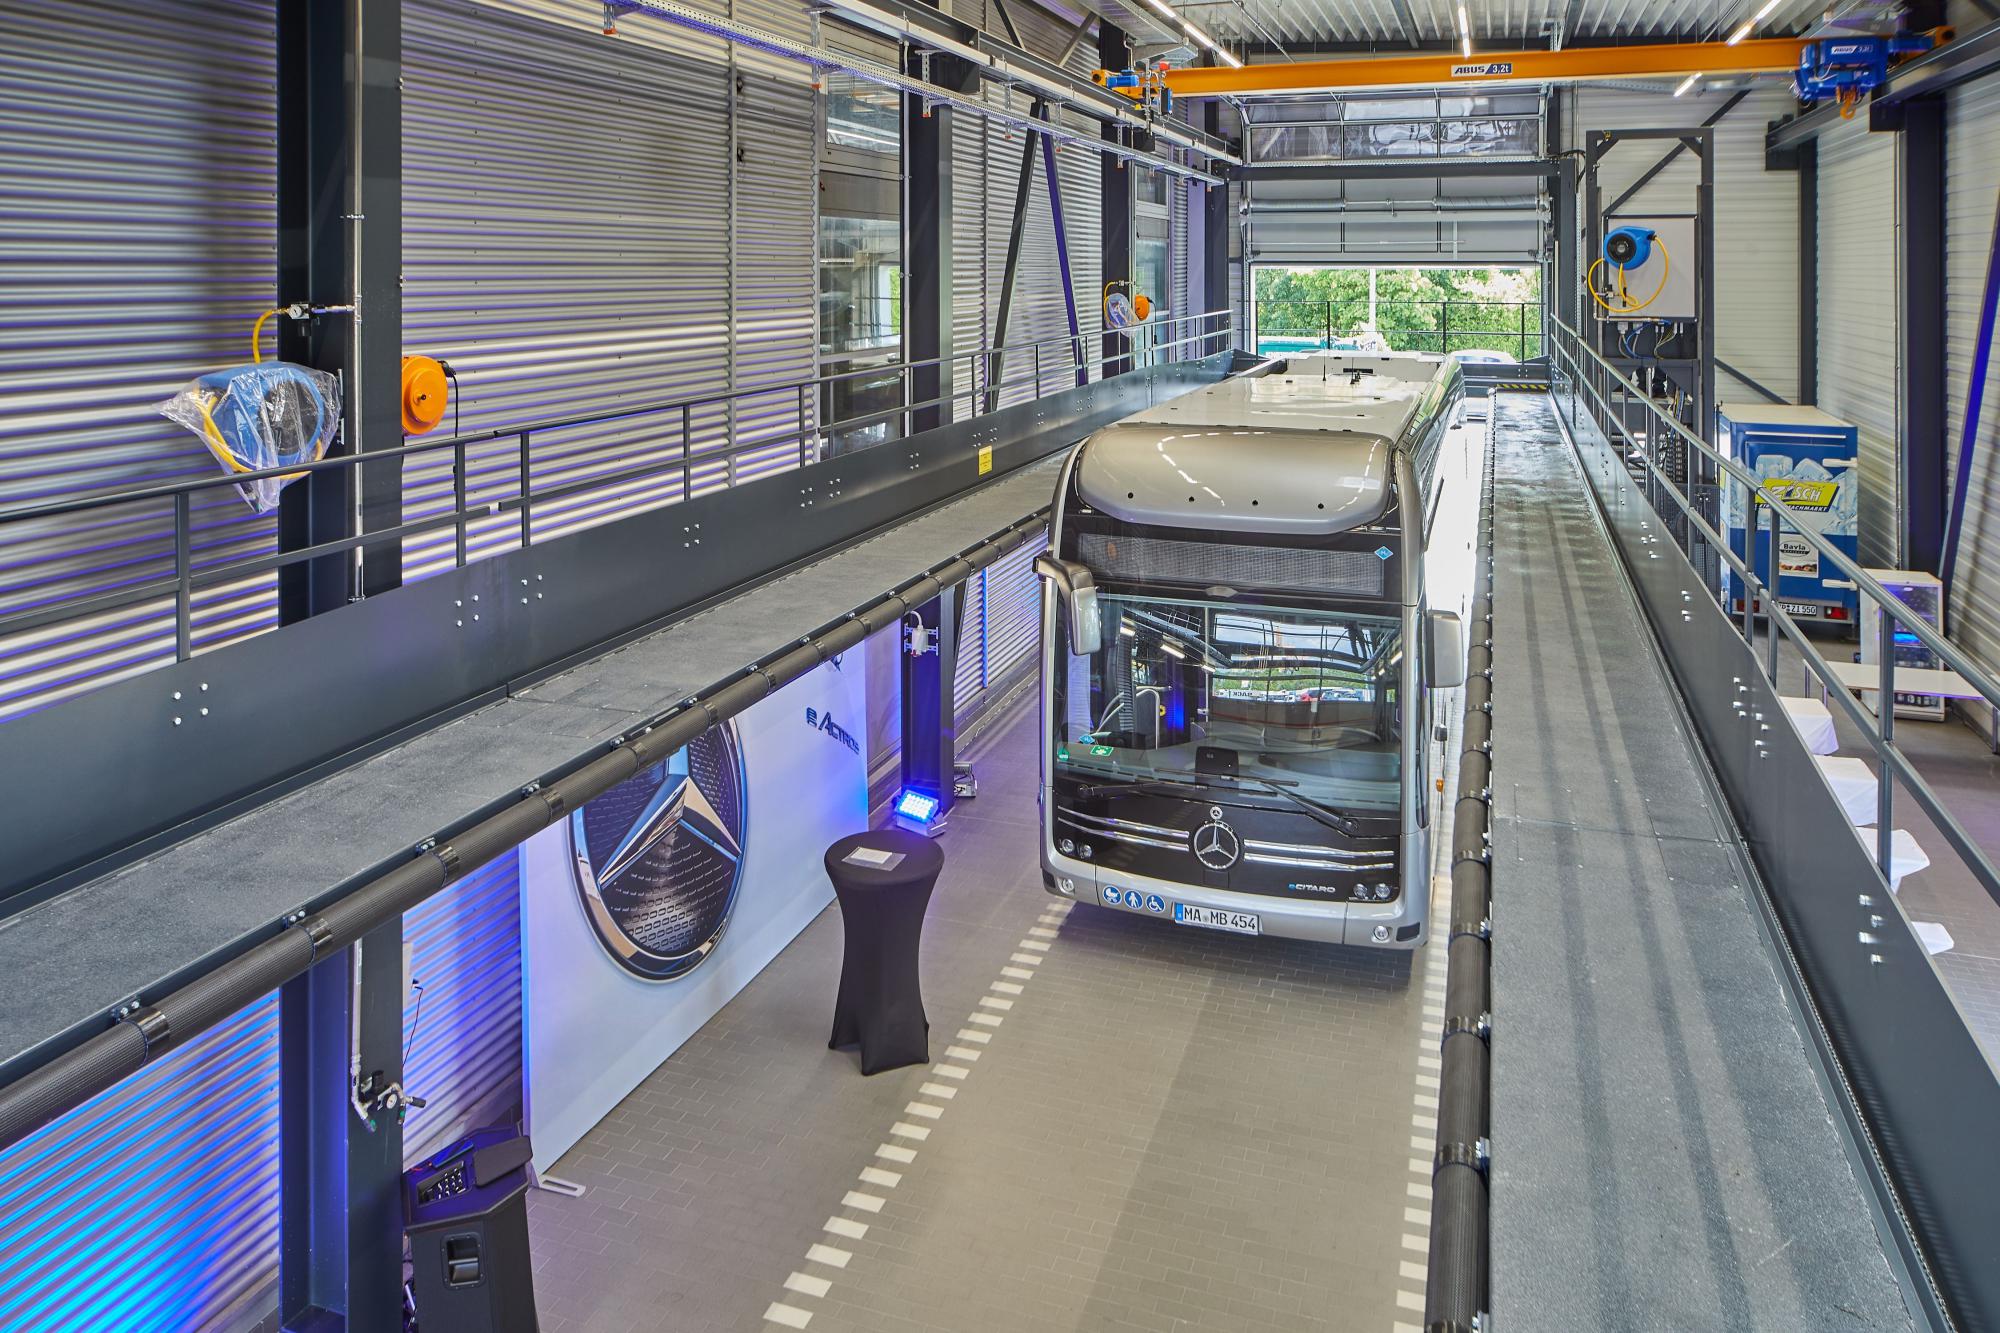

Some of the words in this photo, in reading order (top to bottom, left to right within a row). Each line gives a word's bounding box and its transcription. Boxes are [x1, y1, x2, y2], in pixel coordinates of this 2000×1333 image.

[1454, 66, 1485, 74] ABUS
[1492, 64, 1509, 74] 3,2t
[1184, 906, 1202, 922] MA
[1210, 911, 1228, 926] MB
[1231, 914, 1256, 930] 454
